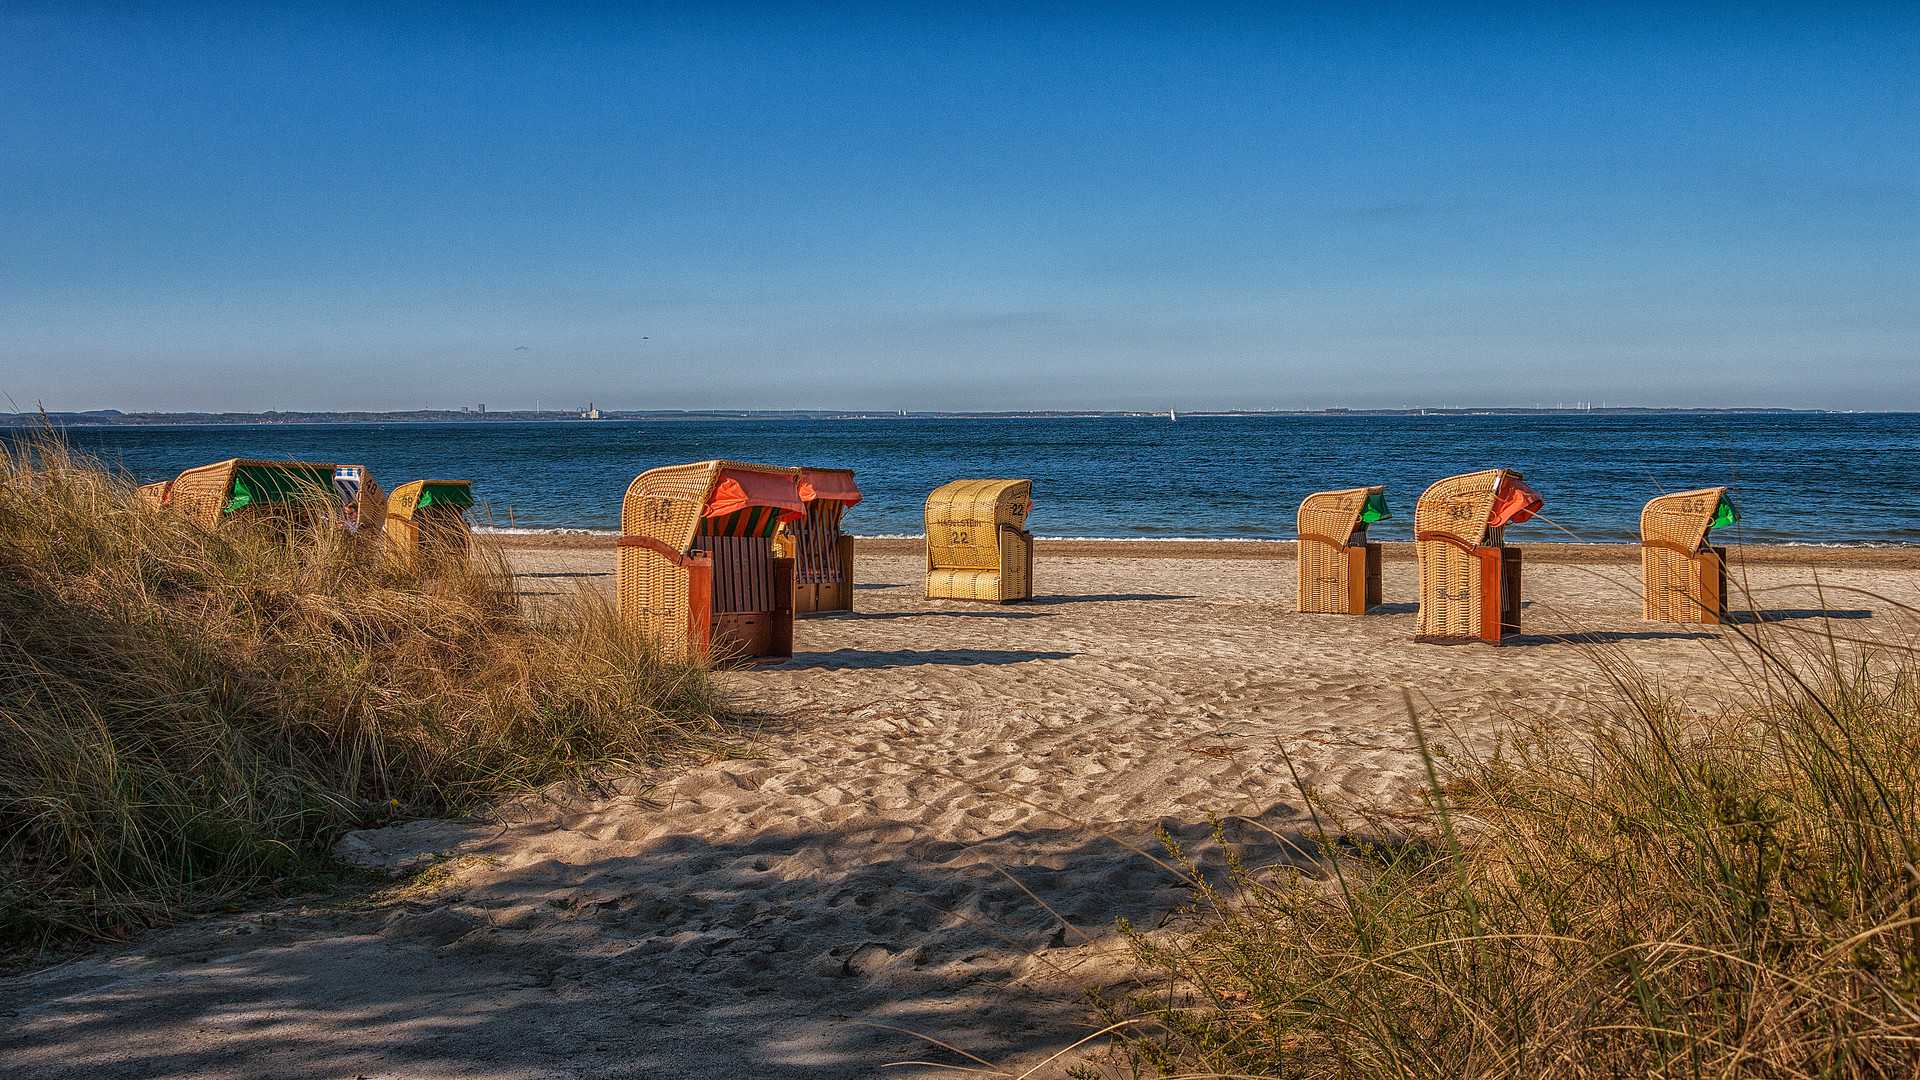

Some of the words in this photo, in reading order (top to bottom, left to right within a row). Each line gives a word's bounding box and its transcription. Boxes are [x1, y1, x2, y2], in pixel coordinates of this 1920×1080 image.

[364, 479, 376, 495] 48
[1011, 504, 1024, 516] 22
[951, 532, 969, 544] 22
